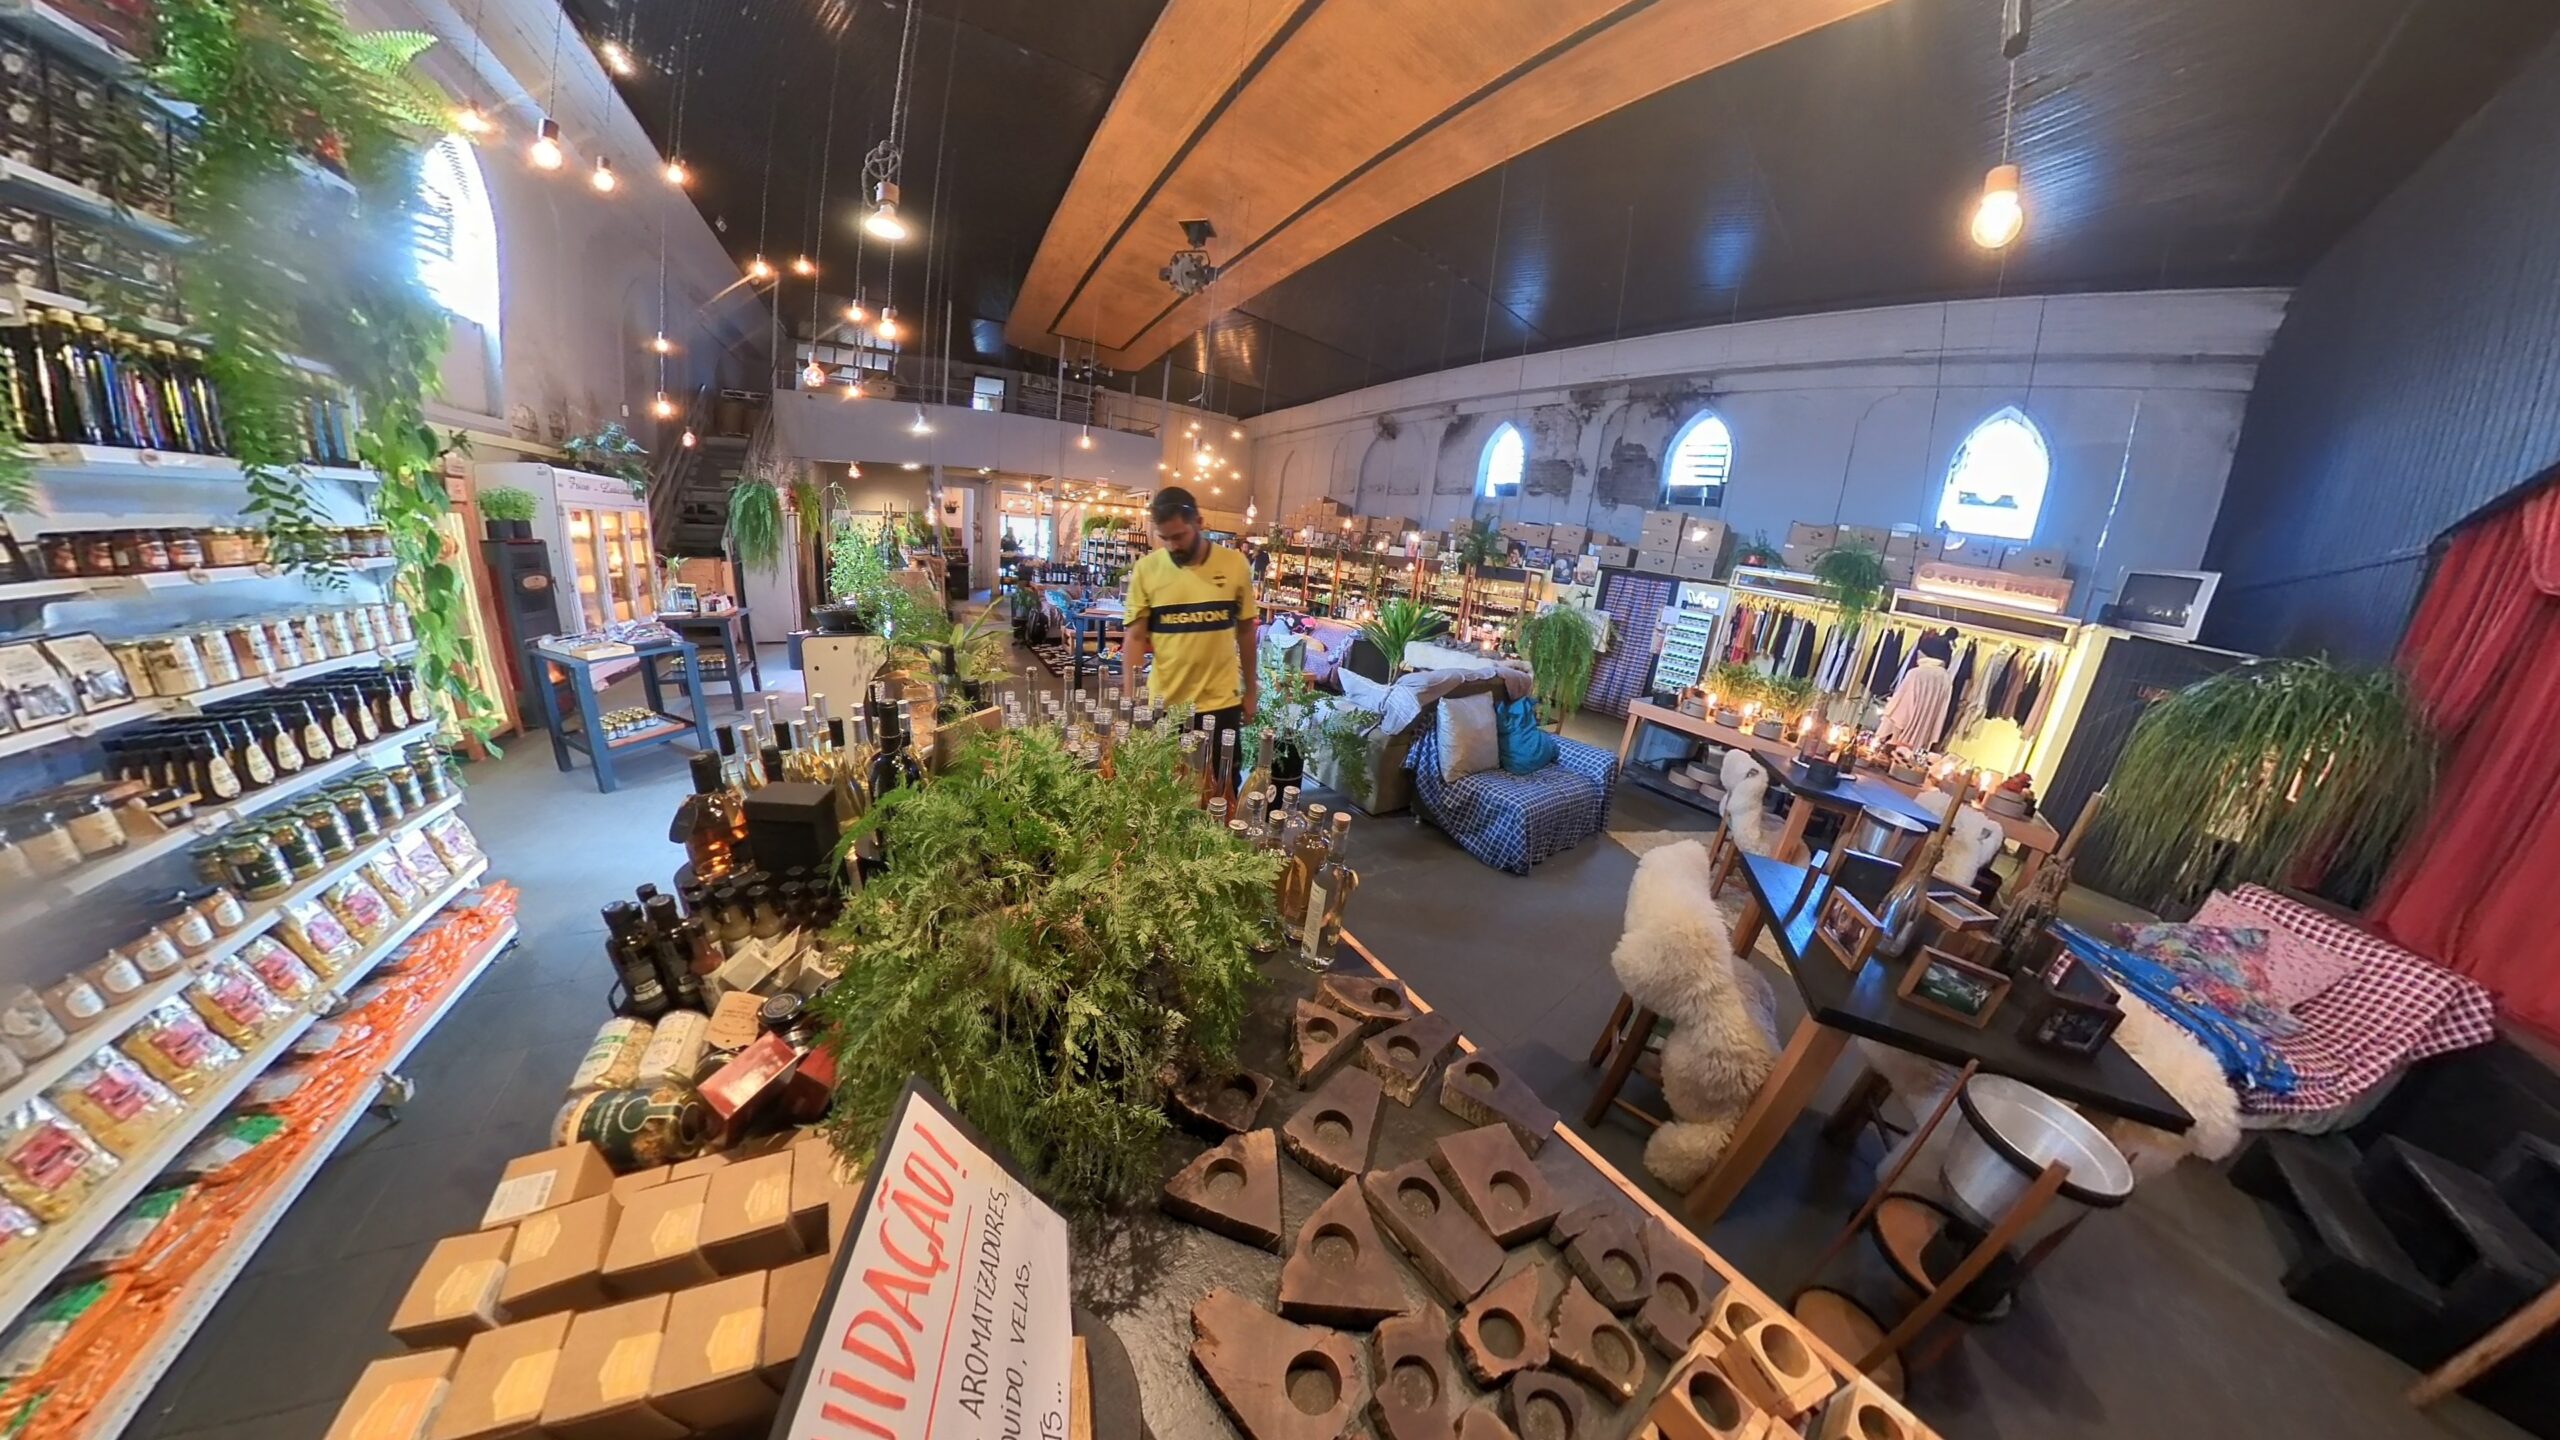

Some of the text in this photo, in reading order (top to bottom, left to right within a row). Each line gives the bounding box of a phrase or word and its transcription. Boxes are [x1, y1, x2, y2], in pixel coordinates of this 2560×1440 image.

[1160, 609, 1230, 625] MEGATONE
[958, 1187, 1010, 1420] AROMATIZADORES,
[1010, 1259, 1034, 1345] VELAS,
